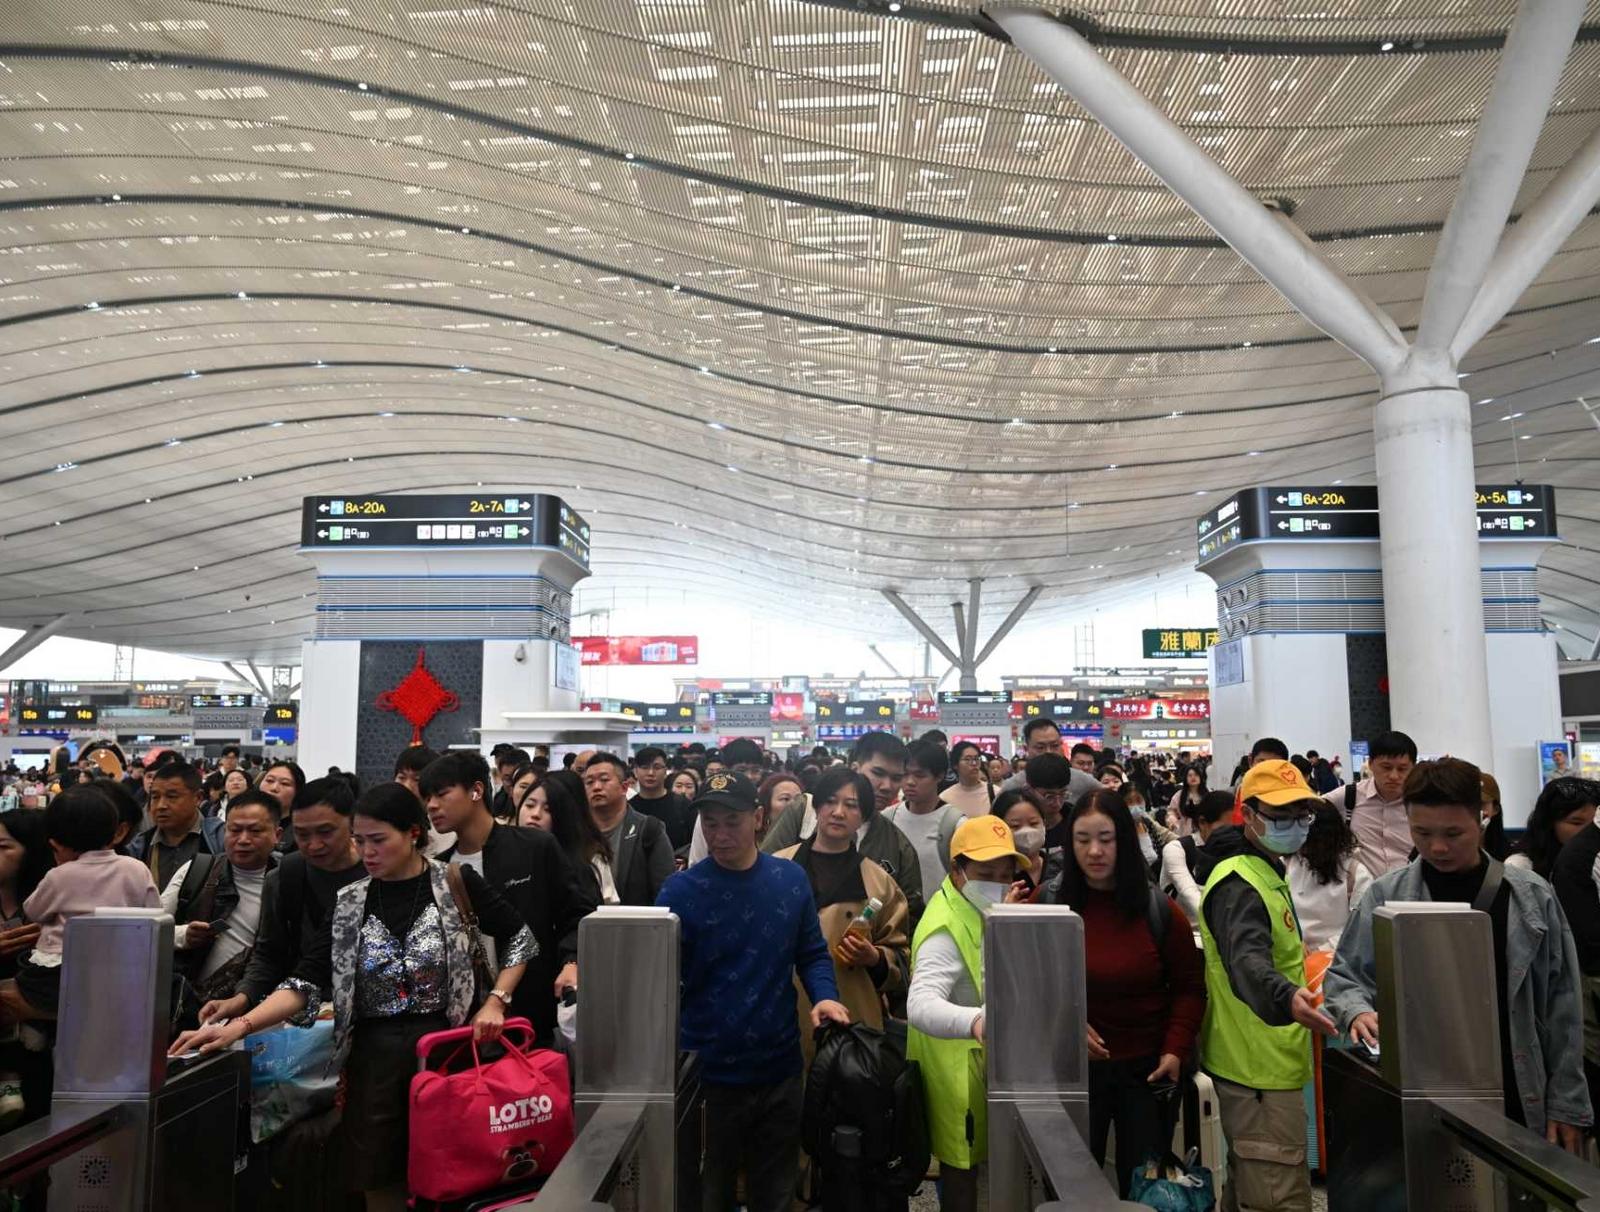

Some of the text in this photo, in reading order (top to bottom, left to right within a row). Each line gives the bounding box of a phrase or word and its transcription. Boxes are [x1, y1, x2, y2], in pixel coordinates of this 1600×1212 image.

[1303, 493, 1346, 505] 6A-20A
[345, 501, 386, 514] 8A-20A
[470, 500, 504, 513] 2A-7A
[489, 1094, 553, 1126] LOTSO
[490, 1112, 553, 1133] STRAWBERRY BEAR
